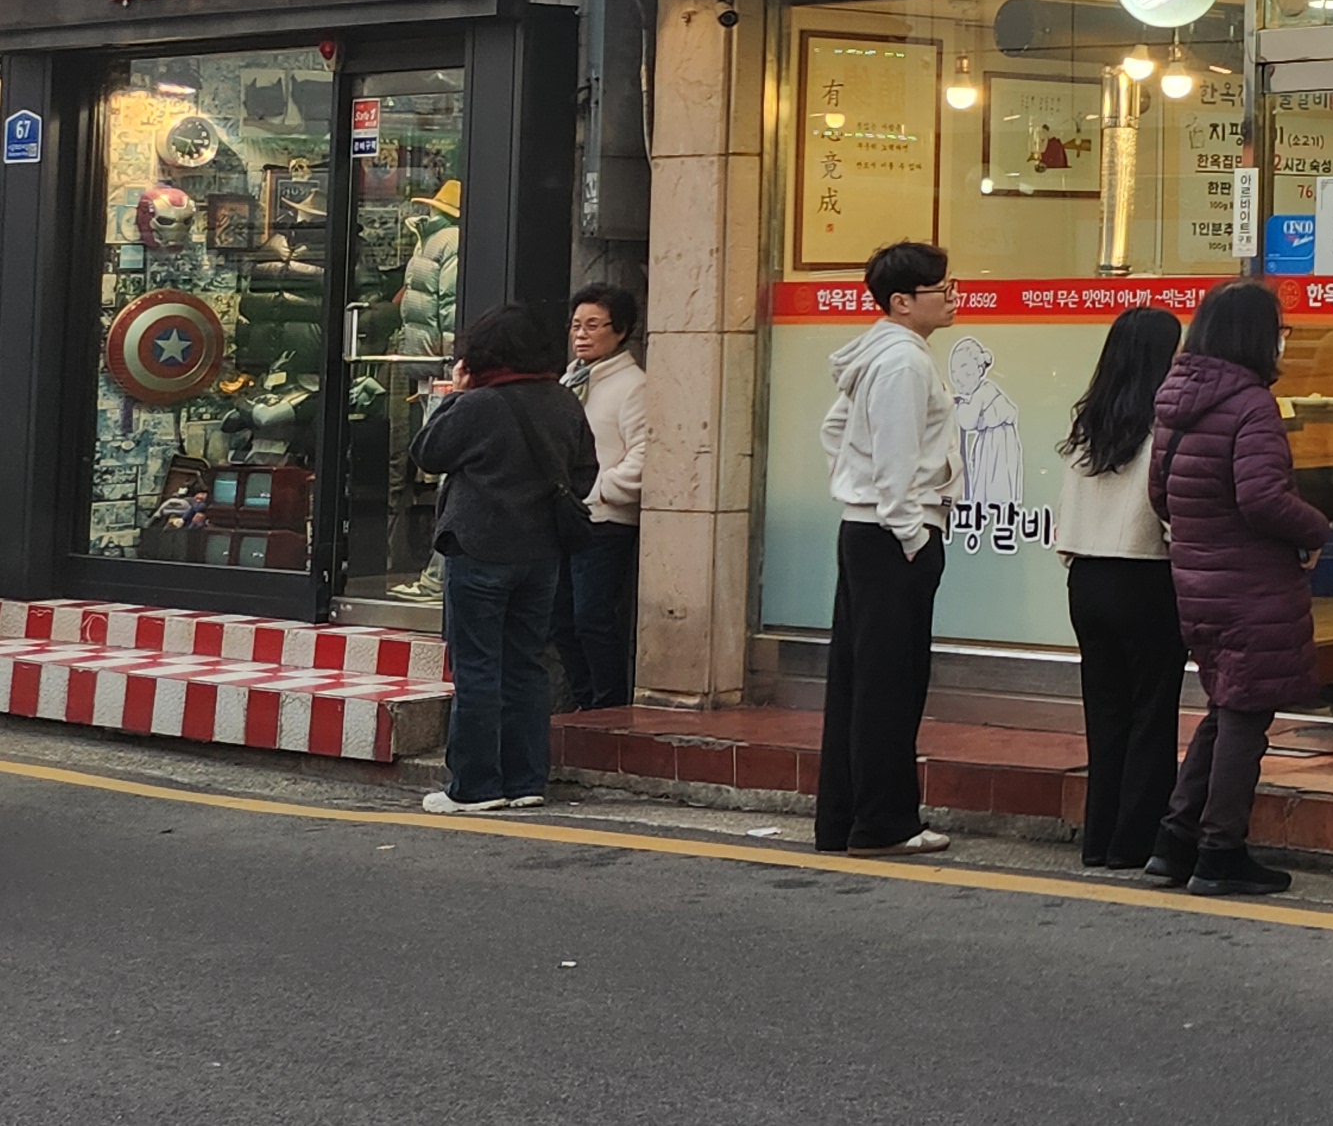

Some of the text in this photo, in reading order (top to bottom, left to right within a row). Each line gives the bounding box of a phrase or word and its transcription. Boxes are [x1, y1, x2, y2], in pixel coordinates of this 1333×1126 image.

[16, 120, 31, 139] 67
[1310, 159, 1332, 173] 숙성
[1208, 182, 1233, 196] 한판
[1192, 223, 1234, 237] 1인분추
[1283, 220, 1314, 235] CESCO
[817, 289, 857, 311] 한옥집
[1056, 289, 1079, 308] 무슨
